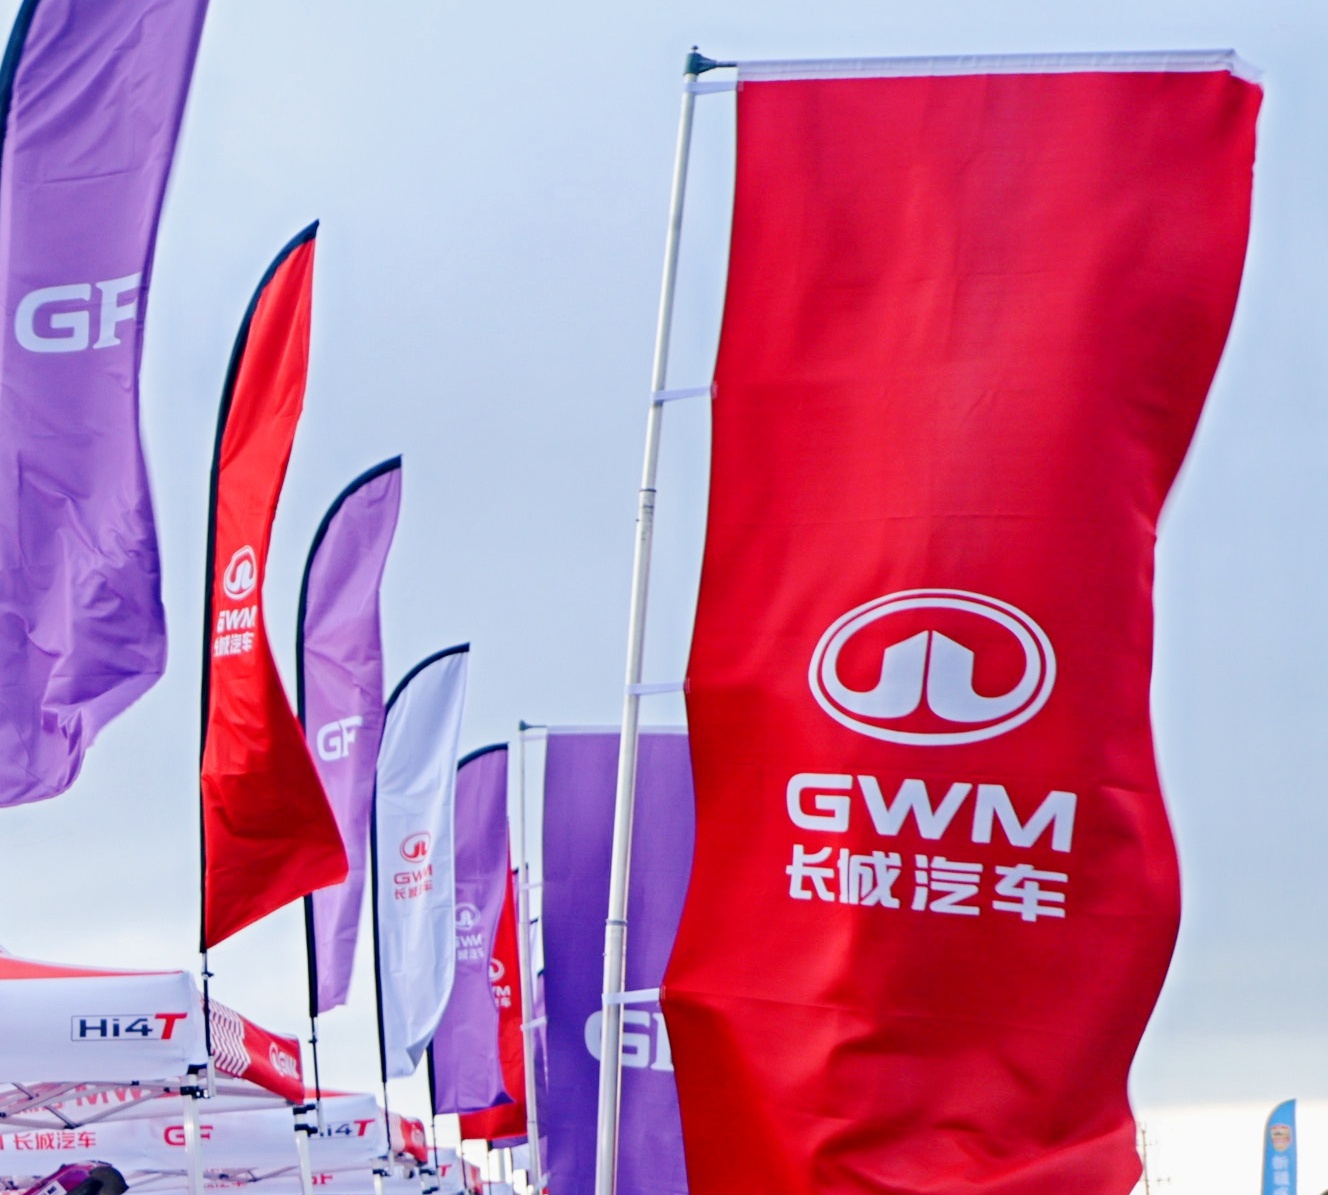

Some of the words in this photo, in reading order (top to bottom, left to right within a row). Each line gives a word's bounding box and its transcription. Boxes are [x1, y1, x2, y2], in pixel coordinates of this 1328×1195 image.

[14, 272, 141, 353] GF
[316, 716, 363, 762] GF
[786, 773, 1077, 853] GWM
[785, 844, 1069, 922] 长城汽车
[77, 1012, 187, 1040] Hi4T
[13, 1130, 96, 1150] 长城汽车
